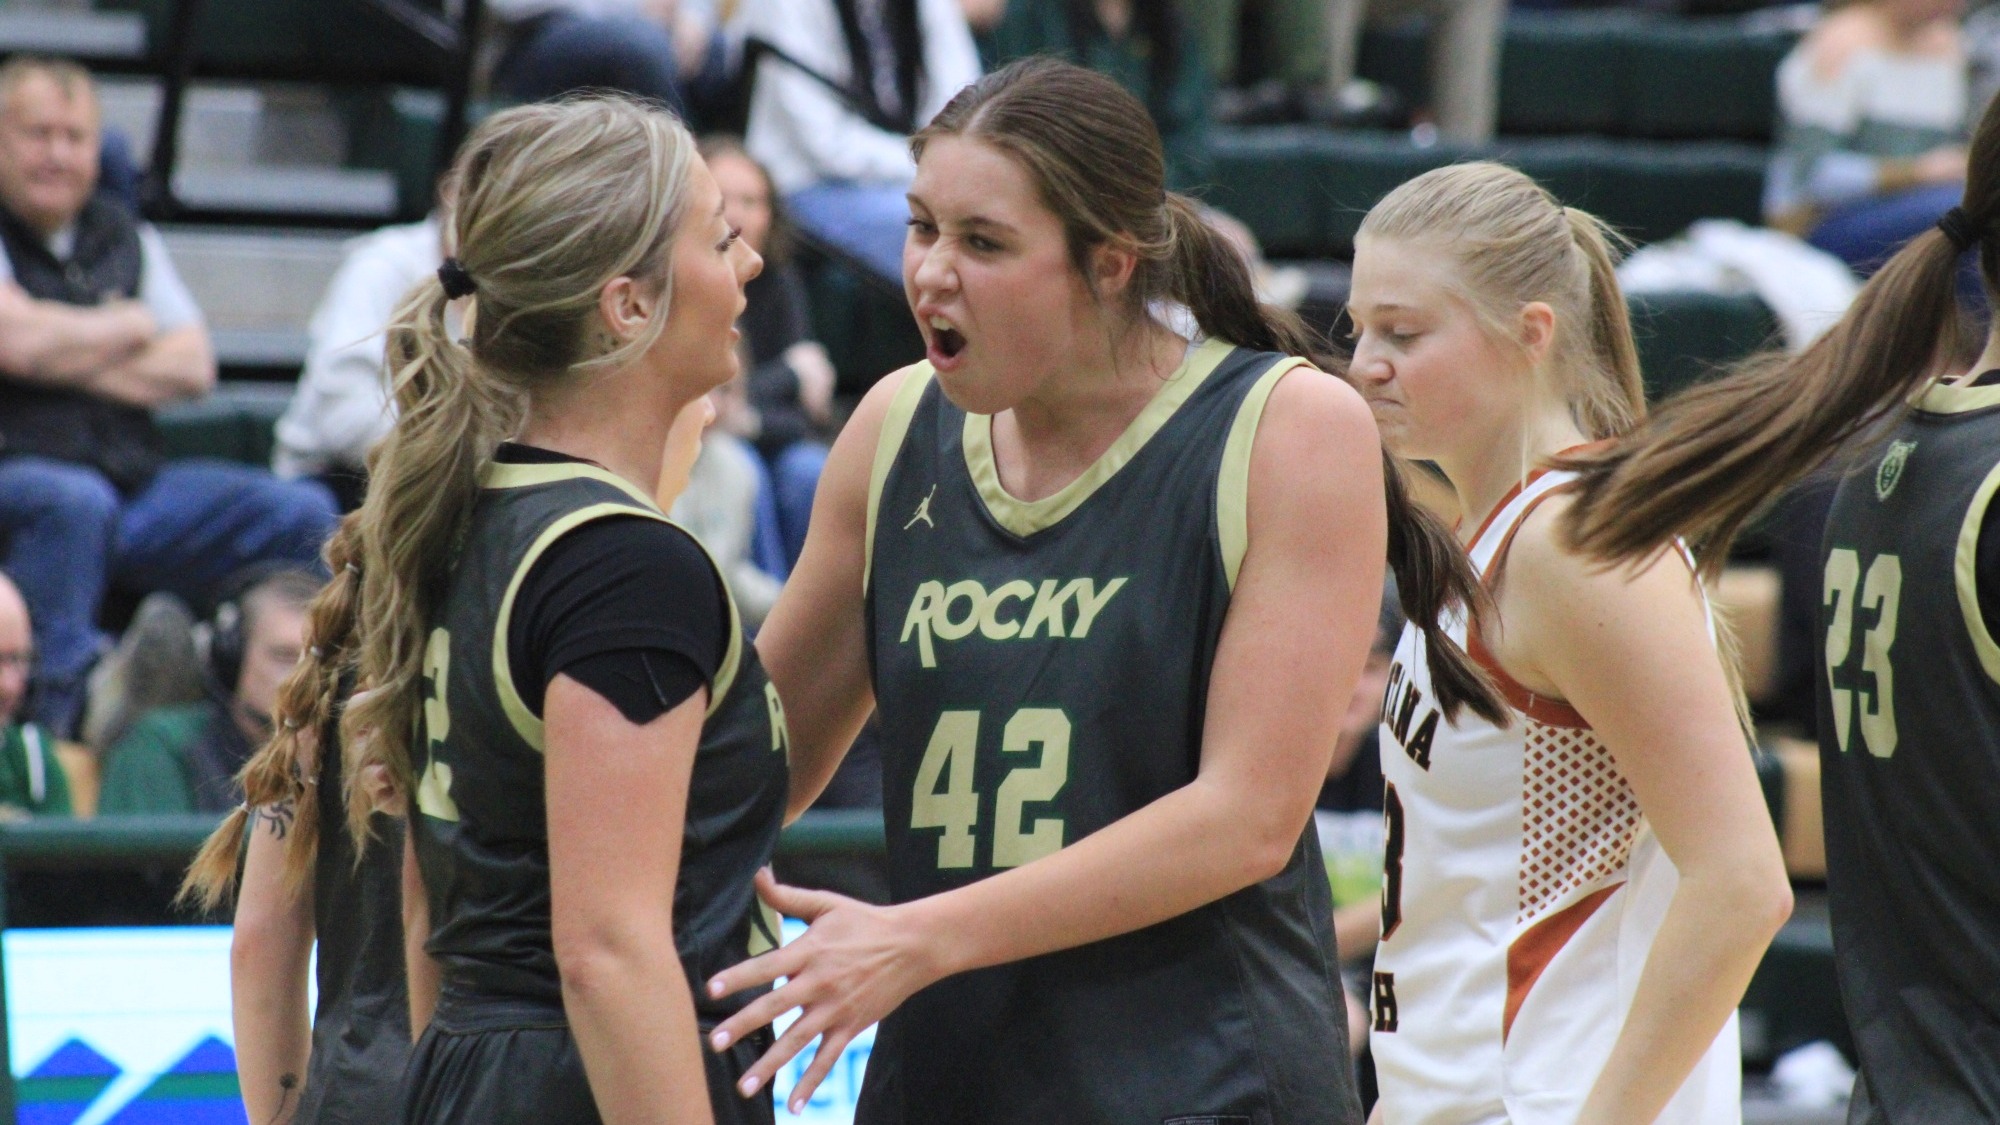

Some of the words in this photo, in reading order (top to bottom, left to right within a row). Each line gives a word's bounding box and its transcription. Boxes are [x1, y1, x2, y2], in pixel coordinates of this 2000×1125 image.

[900, 577, 1129, 668] ROCKY
[1823, 548, 1901, 758] 23
[416, 627, 461, 822] 2
[910, 708, 1071, 868] 42
